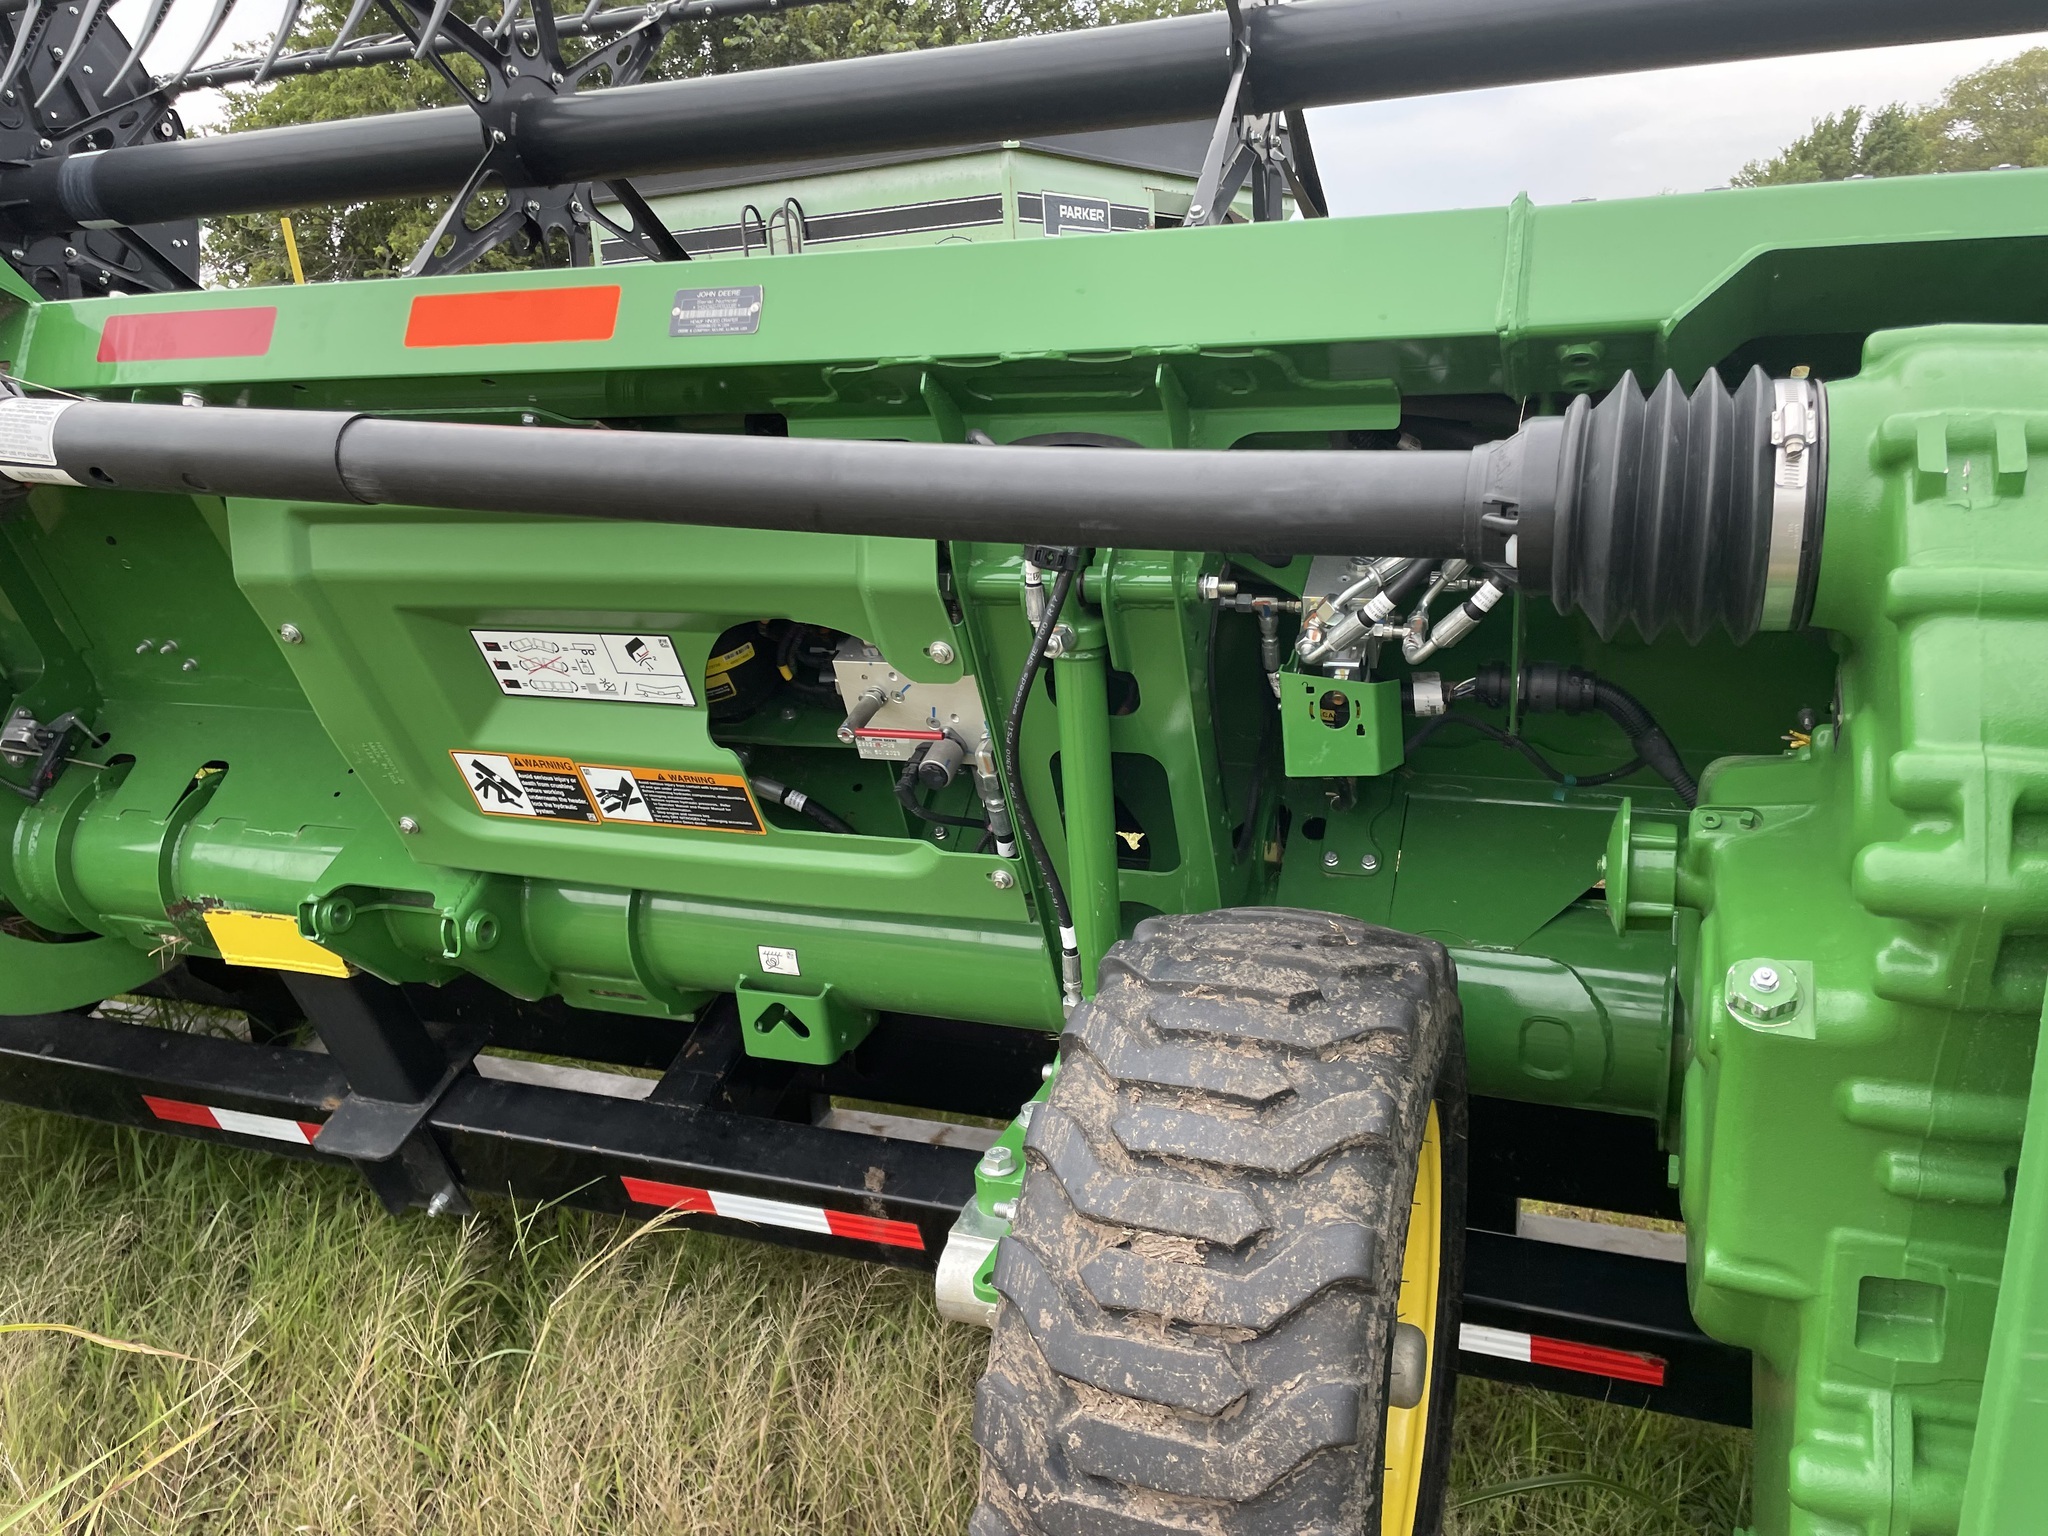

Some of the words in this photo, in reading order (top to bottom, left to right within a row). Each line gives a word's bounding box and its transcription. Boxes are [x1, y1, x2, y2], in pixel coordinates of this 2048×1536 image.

[1060, 205, 1104, 222] PARKER
[697, 290, 716, 298] JOHN
[718, 289, 740, 297] DEERE
[1006, 720, 1014, 745] PSI)
[1012, 672, 1029, 715] exceeds
[1027, 647, 1039, 667] SAE
[1038, 621, 1048, 640] 100
[1046, 594, 1058, 617] R17
[521, 759, 573, 771] WARNING
[518, 772, 533, 780] Avoid
[534, 774, 554, 782] serious
[554, 776, 570, 784] injury
[668, 774, 716, 784] WARNING
[524, 786, 542, 794] Before
[542, 789, 566, 797] working
[528, 794, 558, 802] underneath
[552, 803, 578, 811] hydraulic
